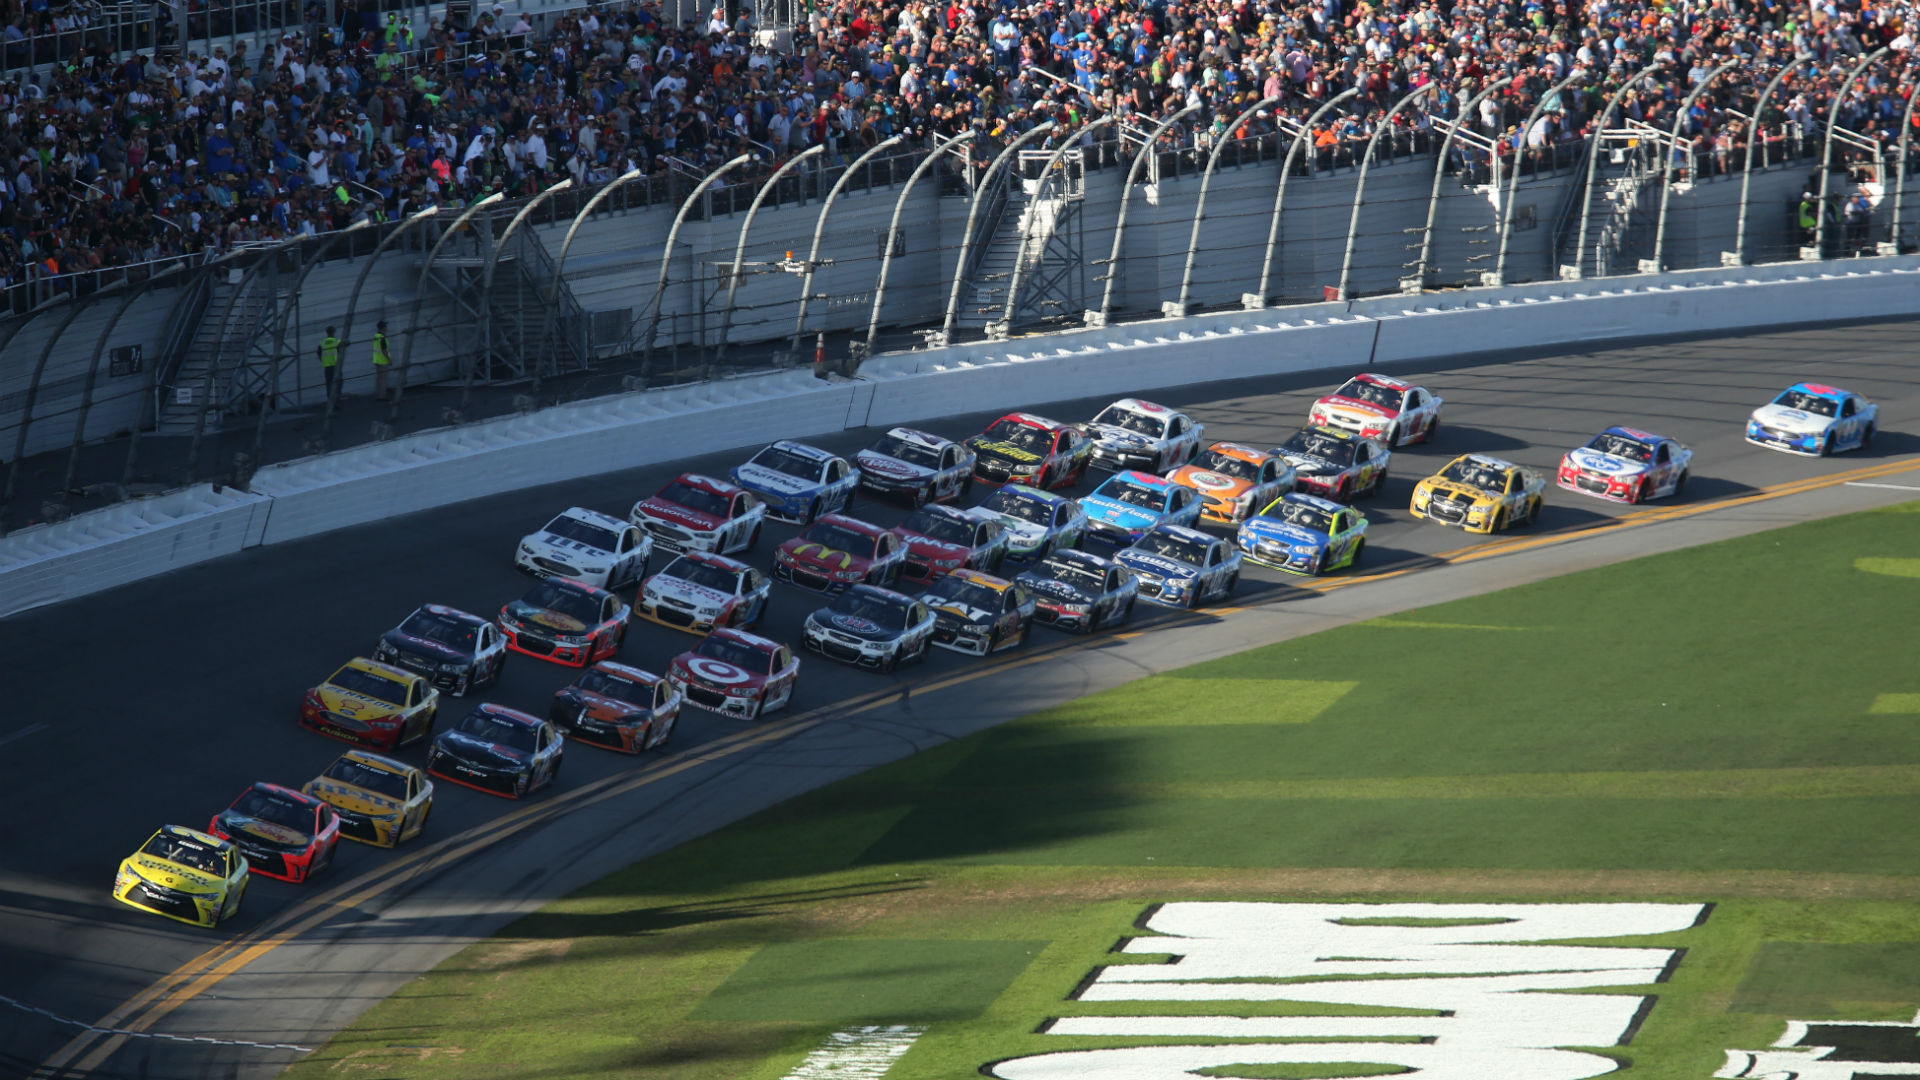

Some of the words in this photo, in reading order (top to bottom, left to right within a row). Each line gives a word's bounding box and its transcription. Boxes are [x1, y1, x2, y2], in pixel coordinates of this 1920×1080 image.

[641, 502, 714, 530] Motorcraft
[1084, 496, 1157, 522] Smithfield
[921, 594, 992, 622] CAT
[326, 685, 397, 711] PENNZOIL
[447, 733, 522, 760] FedEx
[138, 860, 209, 887] GENERAL
